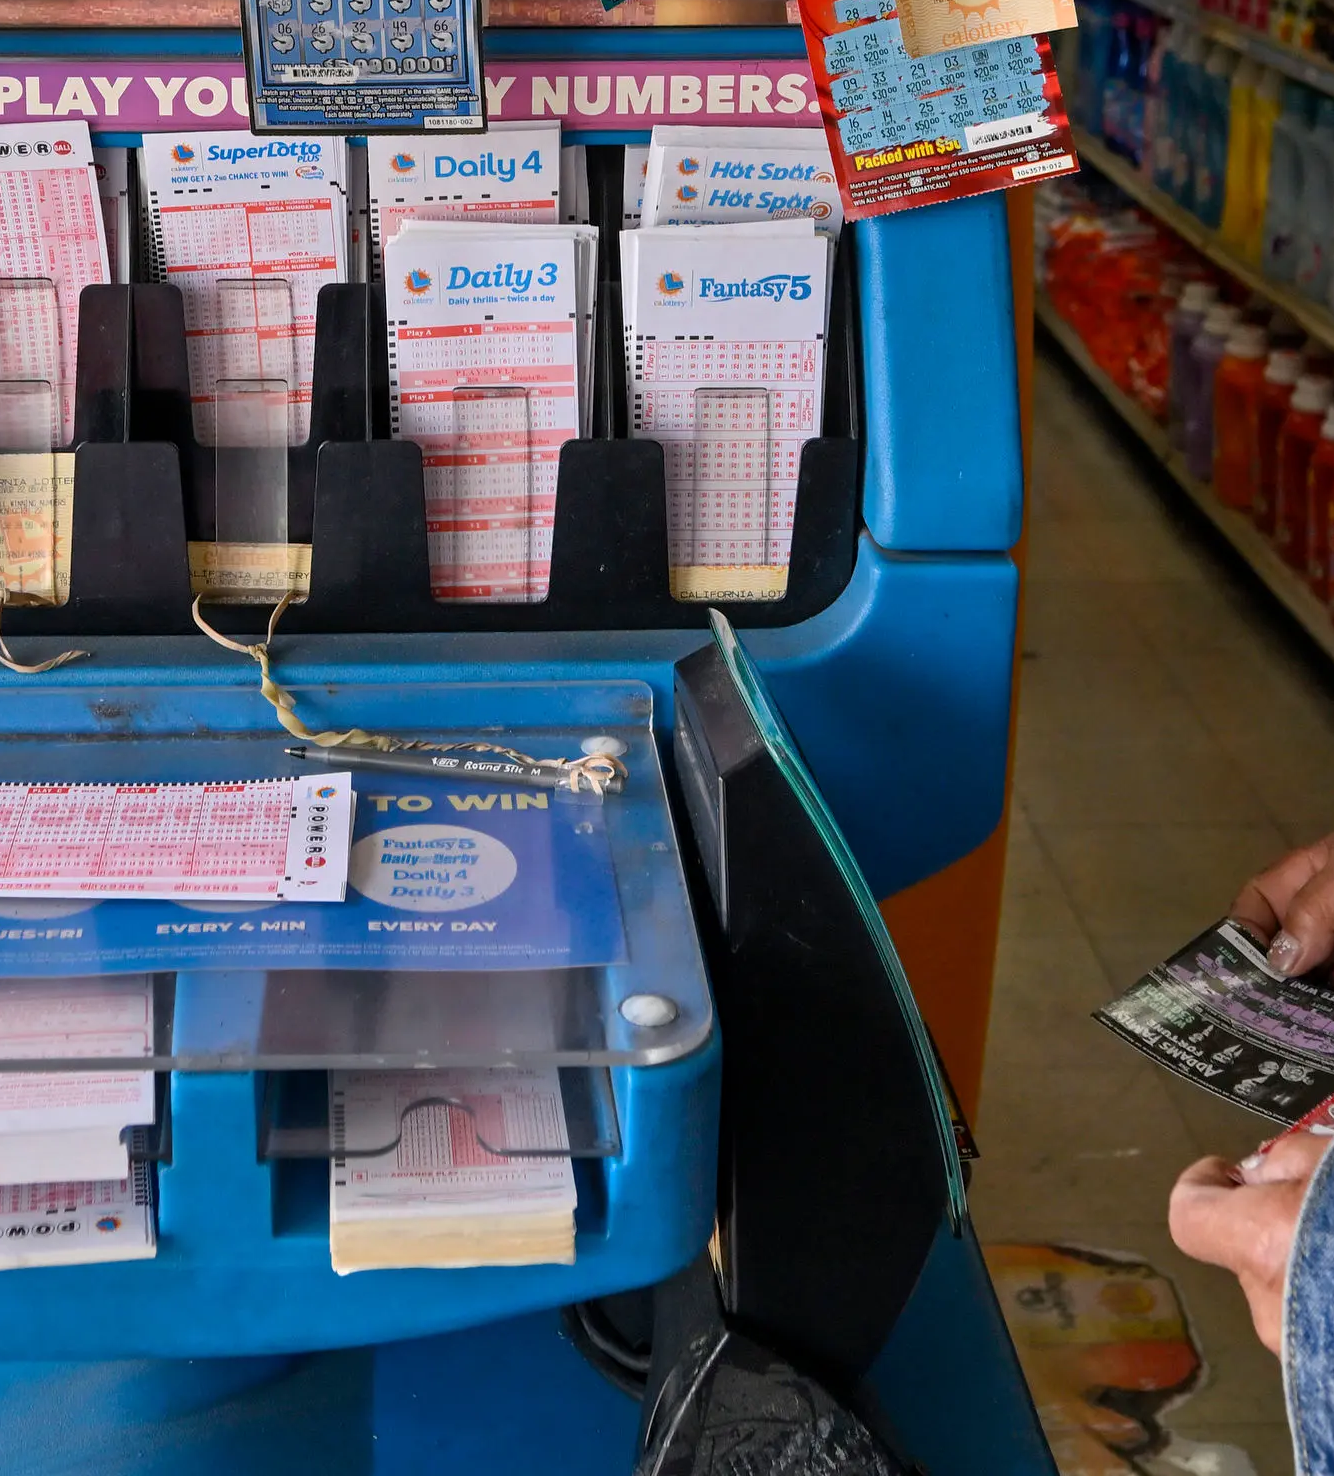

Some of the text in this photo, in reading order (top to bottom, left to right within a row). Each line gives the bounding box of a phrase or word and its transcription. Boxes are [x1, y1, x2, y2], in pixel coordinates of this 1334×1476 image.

[531, 75, 821, 116] NUMBERS.
[207, 141, 322, 163] SuperLotto
[296, 154, 321, 163] PLUS
[228, 172, 259, 181] CHANCE
[273, 170, 289, 178] WIN!
[434, 151, 542, 182] Daily 4
[709, 160, 815, 181] Hot Spot
[445, 262, 557, 294] Daily 3
[699, 274, 813, 302] Fantasy 5
[448, 297, 470, 306] Daily
[473, 296, 498, 304] thrills
[506, 294, 529, 303] twice
[539, 294, 556, 304] day
[464, 761, 501, 772] Round
[369, 795, 433, 812] TO
[447, 793, 549, 812] WIN
[368, 921, 498, 932] EVERY DAY
